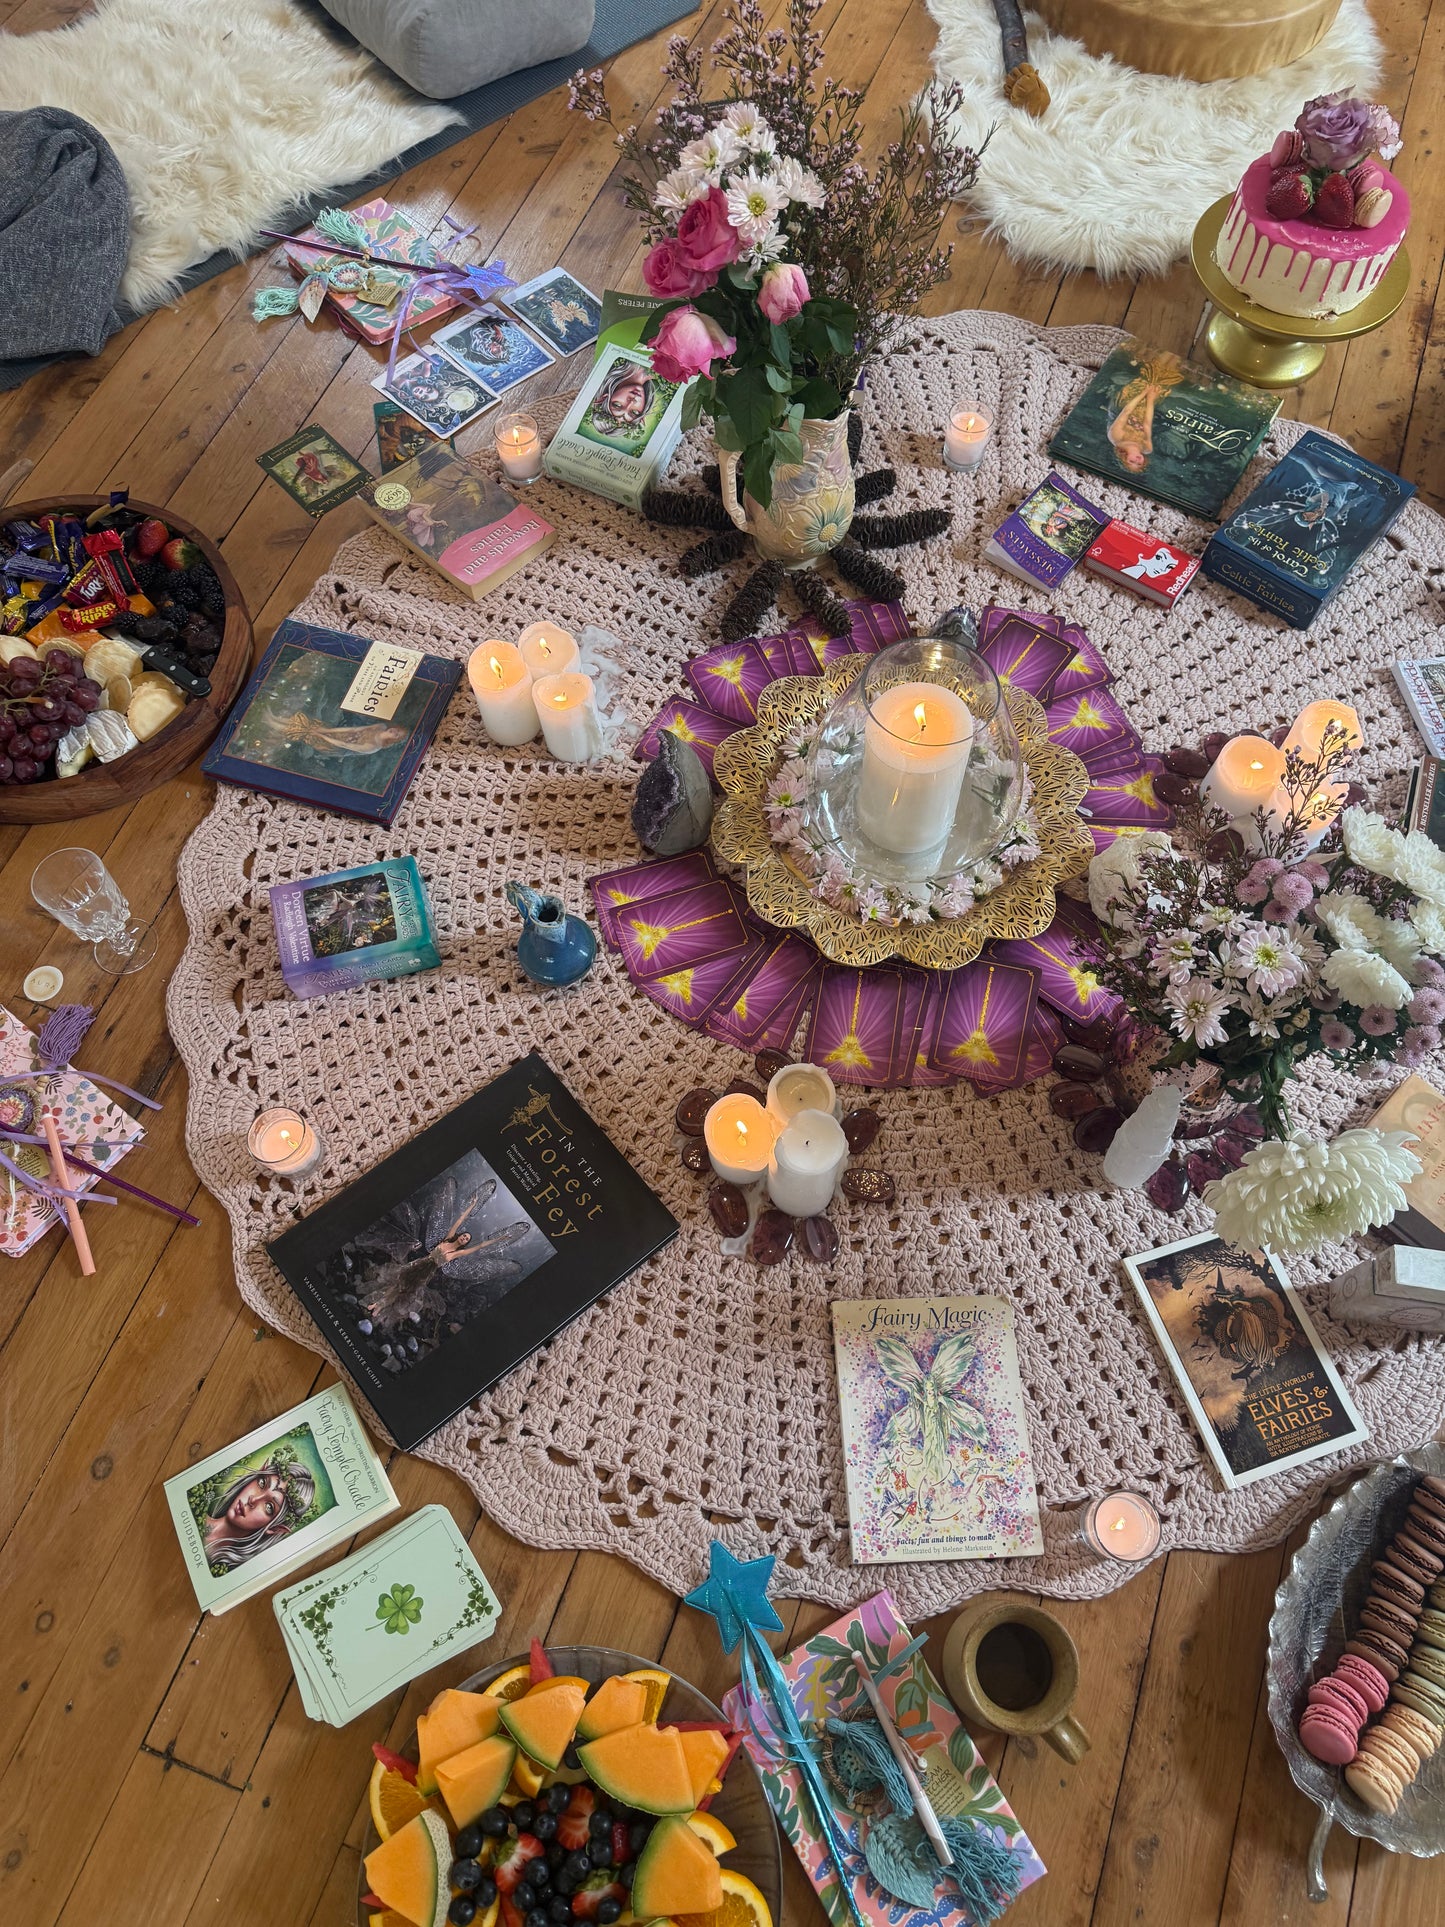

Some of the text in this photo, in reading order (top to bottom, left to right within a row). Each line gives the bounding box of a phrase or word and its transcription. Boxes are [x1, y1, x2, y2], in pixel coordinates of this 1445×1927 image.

[617, 298, 645, 307] PETERS
[1165, 409, 1250, 454] Fairies
[557, 437, 641, 479] Faery Temple Oracle
[463, 519, 539, 575] Rewards and
[470, 523, 512, 553] Fairies
[1006, 529, 1055, 573] MESSAGES
[1245, 520, 1327, 572] Celtic Fairies
[1247, 534, 1310, 578] Tarot of the
[1165, 557, 1198, 596] Redheads
[1219, 562, 1252, 587] Celtic
[1255, 583, 1295, 613] Fairies
[72, 602, 115, 620] CHERRY
[81, 610, 109, 623] RIPE
[1404, 660, 1445, 735] Faery Lifecycle
[1419, 787, 1432, 826] BESTSELLER
[1426, 761, 1437, 787] FAERIES
[283, 901, 295, 930] Radleigh
[386, 867, 413, 918] FAIRY
[400, 920, 410, 938] CARDS
[291, 890, 311, 962] Doreen Virtue
[288, 930, 300, 964] Valentine
[30, 978, 54, 989] AURA
[505, 1149, 519, 1165] Unique
[522, 1170, 537, 1188] Magical
[510, 1143, 525, 1161] Discover
[557, 1134, 603, 1187] IN THE
[519, 1178, 531, 1192] World
[523, 1122, 605, 1222] Forest
[531, 1182, 579, 1236] Fey
[861, 1304, 986, 1332] Fairy Magic
[364, 1365, 383, 1390] SCHIFF
[1243, 1371, 1315, 1401] THE LITTLE WORLD OF
[1247, 1385, 1309, 1422] ELVES
[1256, 1399, 1333, 1441] FAIRIES
[316, 1397, 370, 1509] Faery Temple Oracle
[1267, 1443, 1281, 1452] WITH
[1282, 1430, 1317, 1446] ILLUSTRATIONS
[1269, 1431, 1330, 1457] IDA RENTOUL OUTHWAITE
[1272, 1430, 1300, 1444] ANTHOLOGY
[1306, 1423, 1321, 1432] VERSE
[355, 1443, 369, 1471] CHRISTINE
[366, 1470, 379, 1494] KARRON
[179, 1509, 204, 1568] GUIDEBOOK
[916, 1537, 929, 1545] fun
[945, 1535, 966, 1543] things
[924, 1768, 952, 1796] ATCHER
